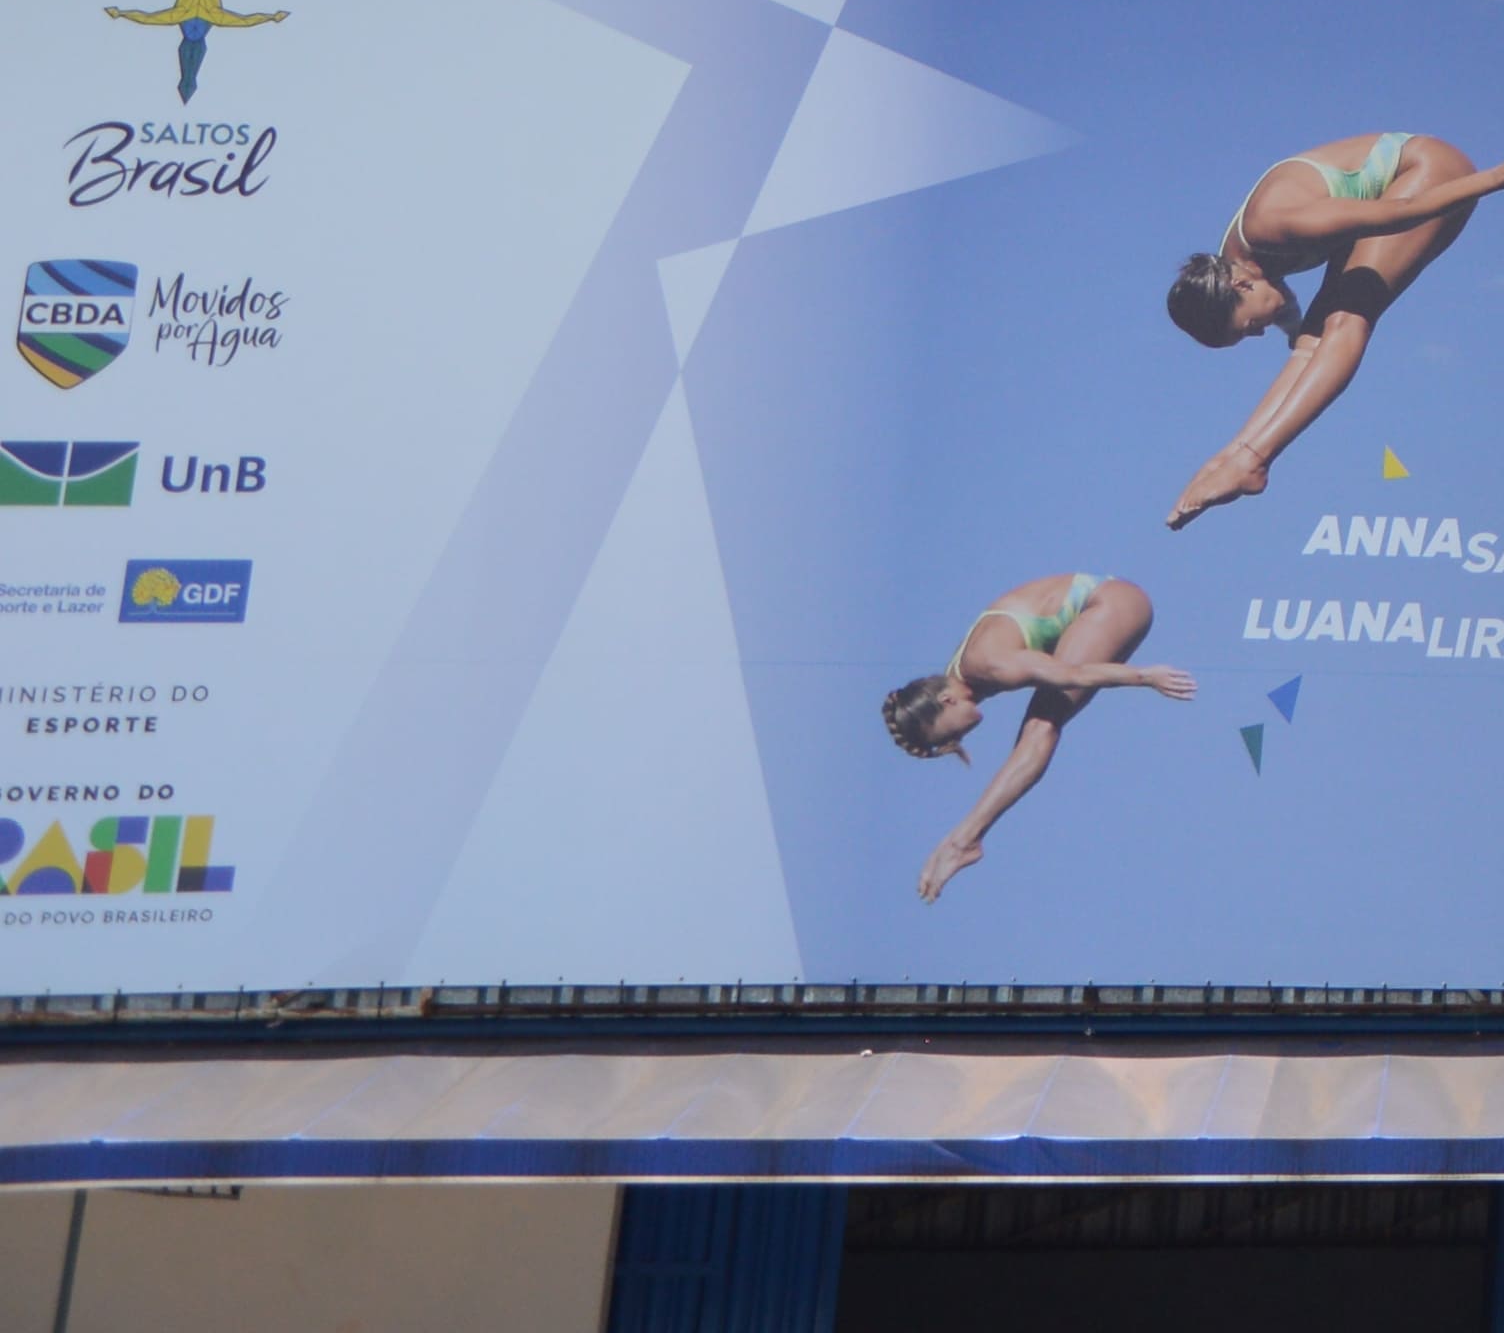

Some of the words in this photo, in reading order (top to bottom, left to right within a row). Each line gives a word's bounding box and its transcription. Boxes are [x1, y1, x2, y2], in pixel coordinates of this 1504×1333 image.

[141, 122, 251, 146] SALTOS
[63, 121, 278, 207] Brasil
[148, 272, 290, 321] Movidos
[25, 302, 125, 326] CBDA
[155, 318, 199, 353] por
[187, 313, 283, 367] Água
[161, 455, 267, 494] UnB
[0, 583, 80, 598] Secretaria
[85, 583, 106, 598] de
[183, 583, 241, 605] GDF
[42, 603, 51, 614] e
[57, 601, 104, 614] Lazer
[171, 685, 209, 703] DO
[26, 716, 159, 734] ESPORTE
[0, 784, 120, 802] OVERNO
[138, 783, 175, 801] DO
[4, 911, 33, 926] DO
[41, 909, 95, 925] POVO
[103, 908, 214, 924] BRASILEIRO
